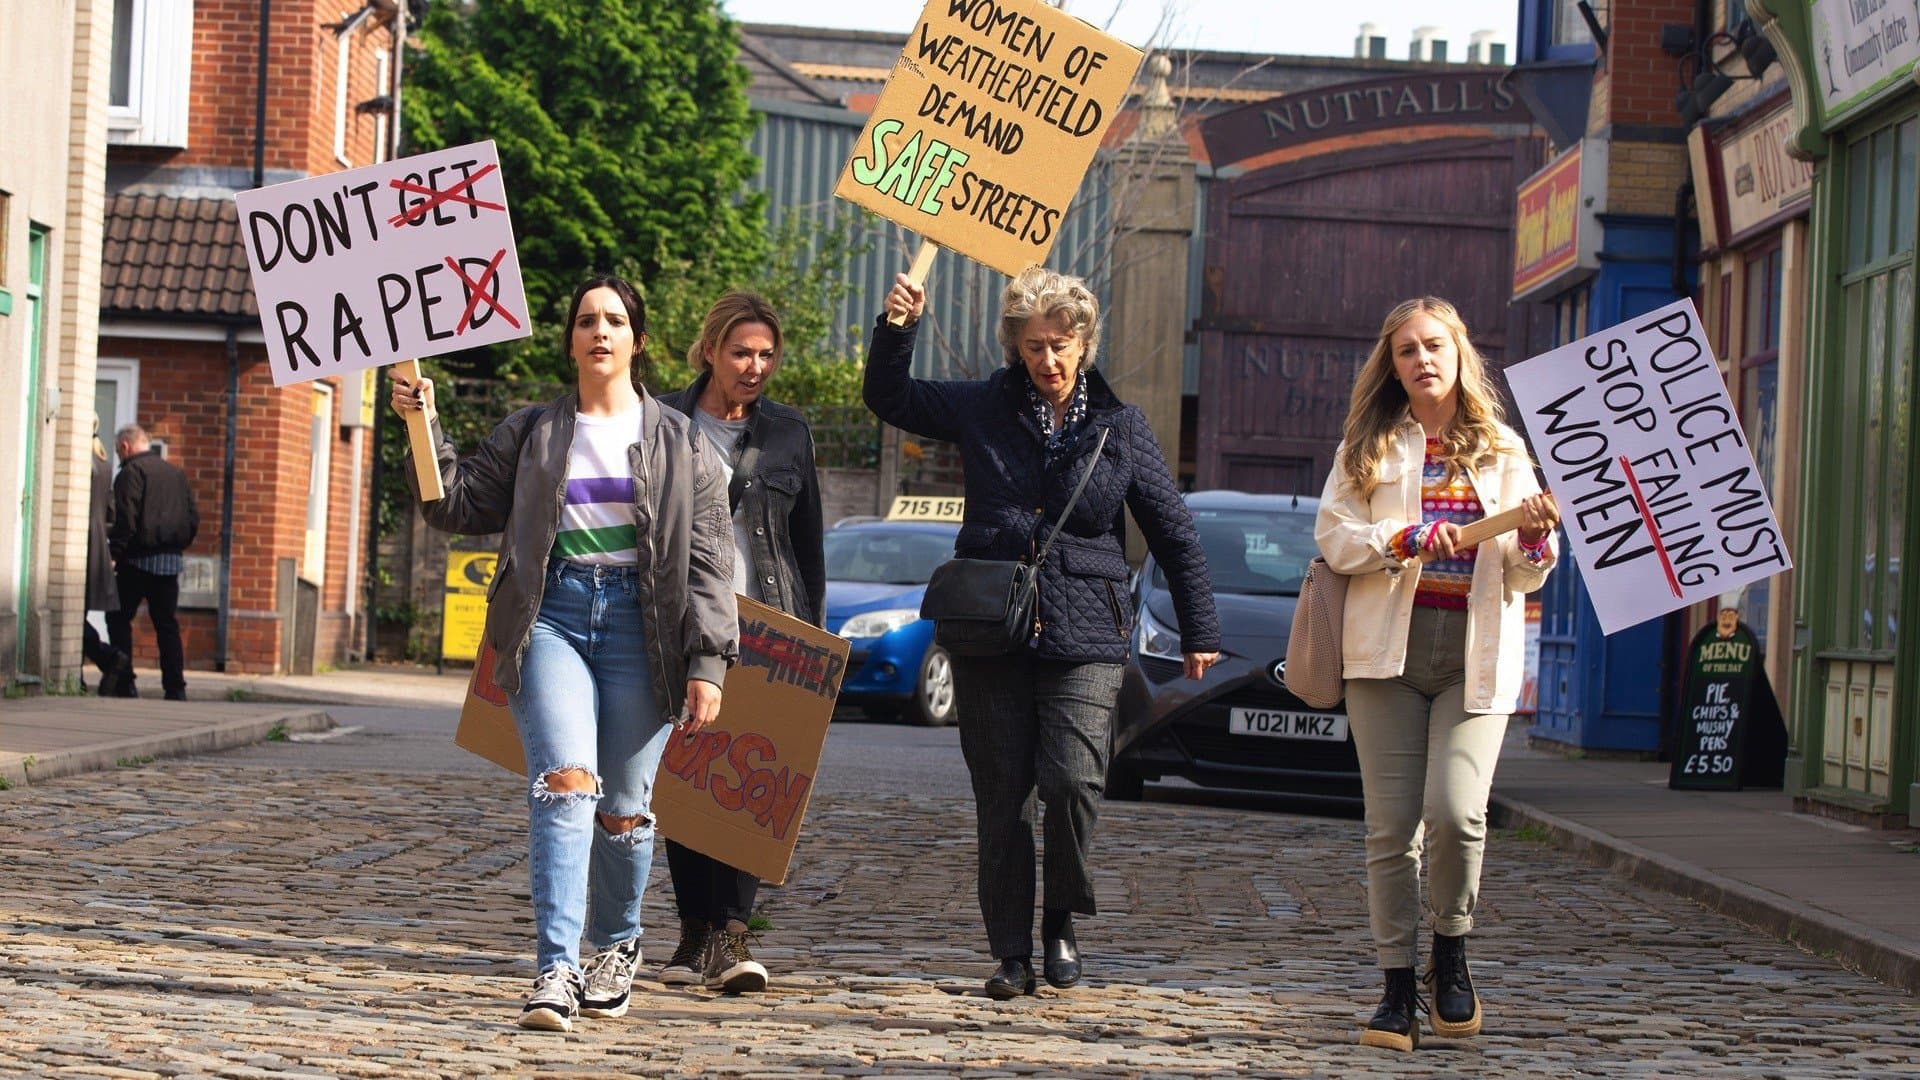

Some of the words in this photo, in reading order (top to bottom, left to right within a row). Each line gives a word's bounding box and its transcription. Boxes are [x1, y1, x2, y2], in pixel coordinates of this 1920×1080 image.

[947, 0, 1056, 64] WOMEN
[1063, 45, 1109, 86] OF
[1881, 13, 1908, 54] Centre
[918, 23, 1102, 138] WEATHERFIELD
[1262, 77, 1518, 139] NUTTALL'S
[917, 83, 1024, 155] DEMAND
[249, 181, 379, 273] DON'T
[398, 159, 479, 227] GET
[852, 119, 970, 216] SAFE
[951, 171, 1060, 246] STREETS
[275, 256, 501, 372] RAPED
[1584, 338, 1658, 433] STOP
[1630, 448, 1721, 587] FAILING
[1635, 310, 1743, 467] POLICE
[1700, 466, 1786, 573] MUST
[898, 500, 932, 516] 715
[936, 501, 964, 516] 151
[1535, 386, 1655, 570] WOMEN
[1699, 641, 1752, 663] MENU
[1244, 711, 1290, 734] YO21
[1294, 715, 1336, 737] MKZ
[1692, 705, 1729, 720] CHIPS
[1730, 703, 1740, 720] &
[1696, 719, 1735, 740] MUSHY
[1699, 735, 1728, 751] PEAS
